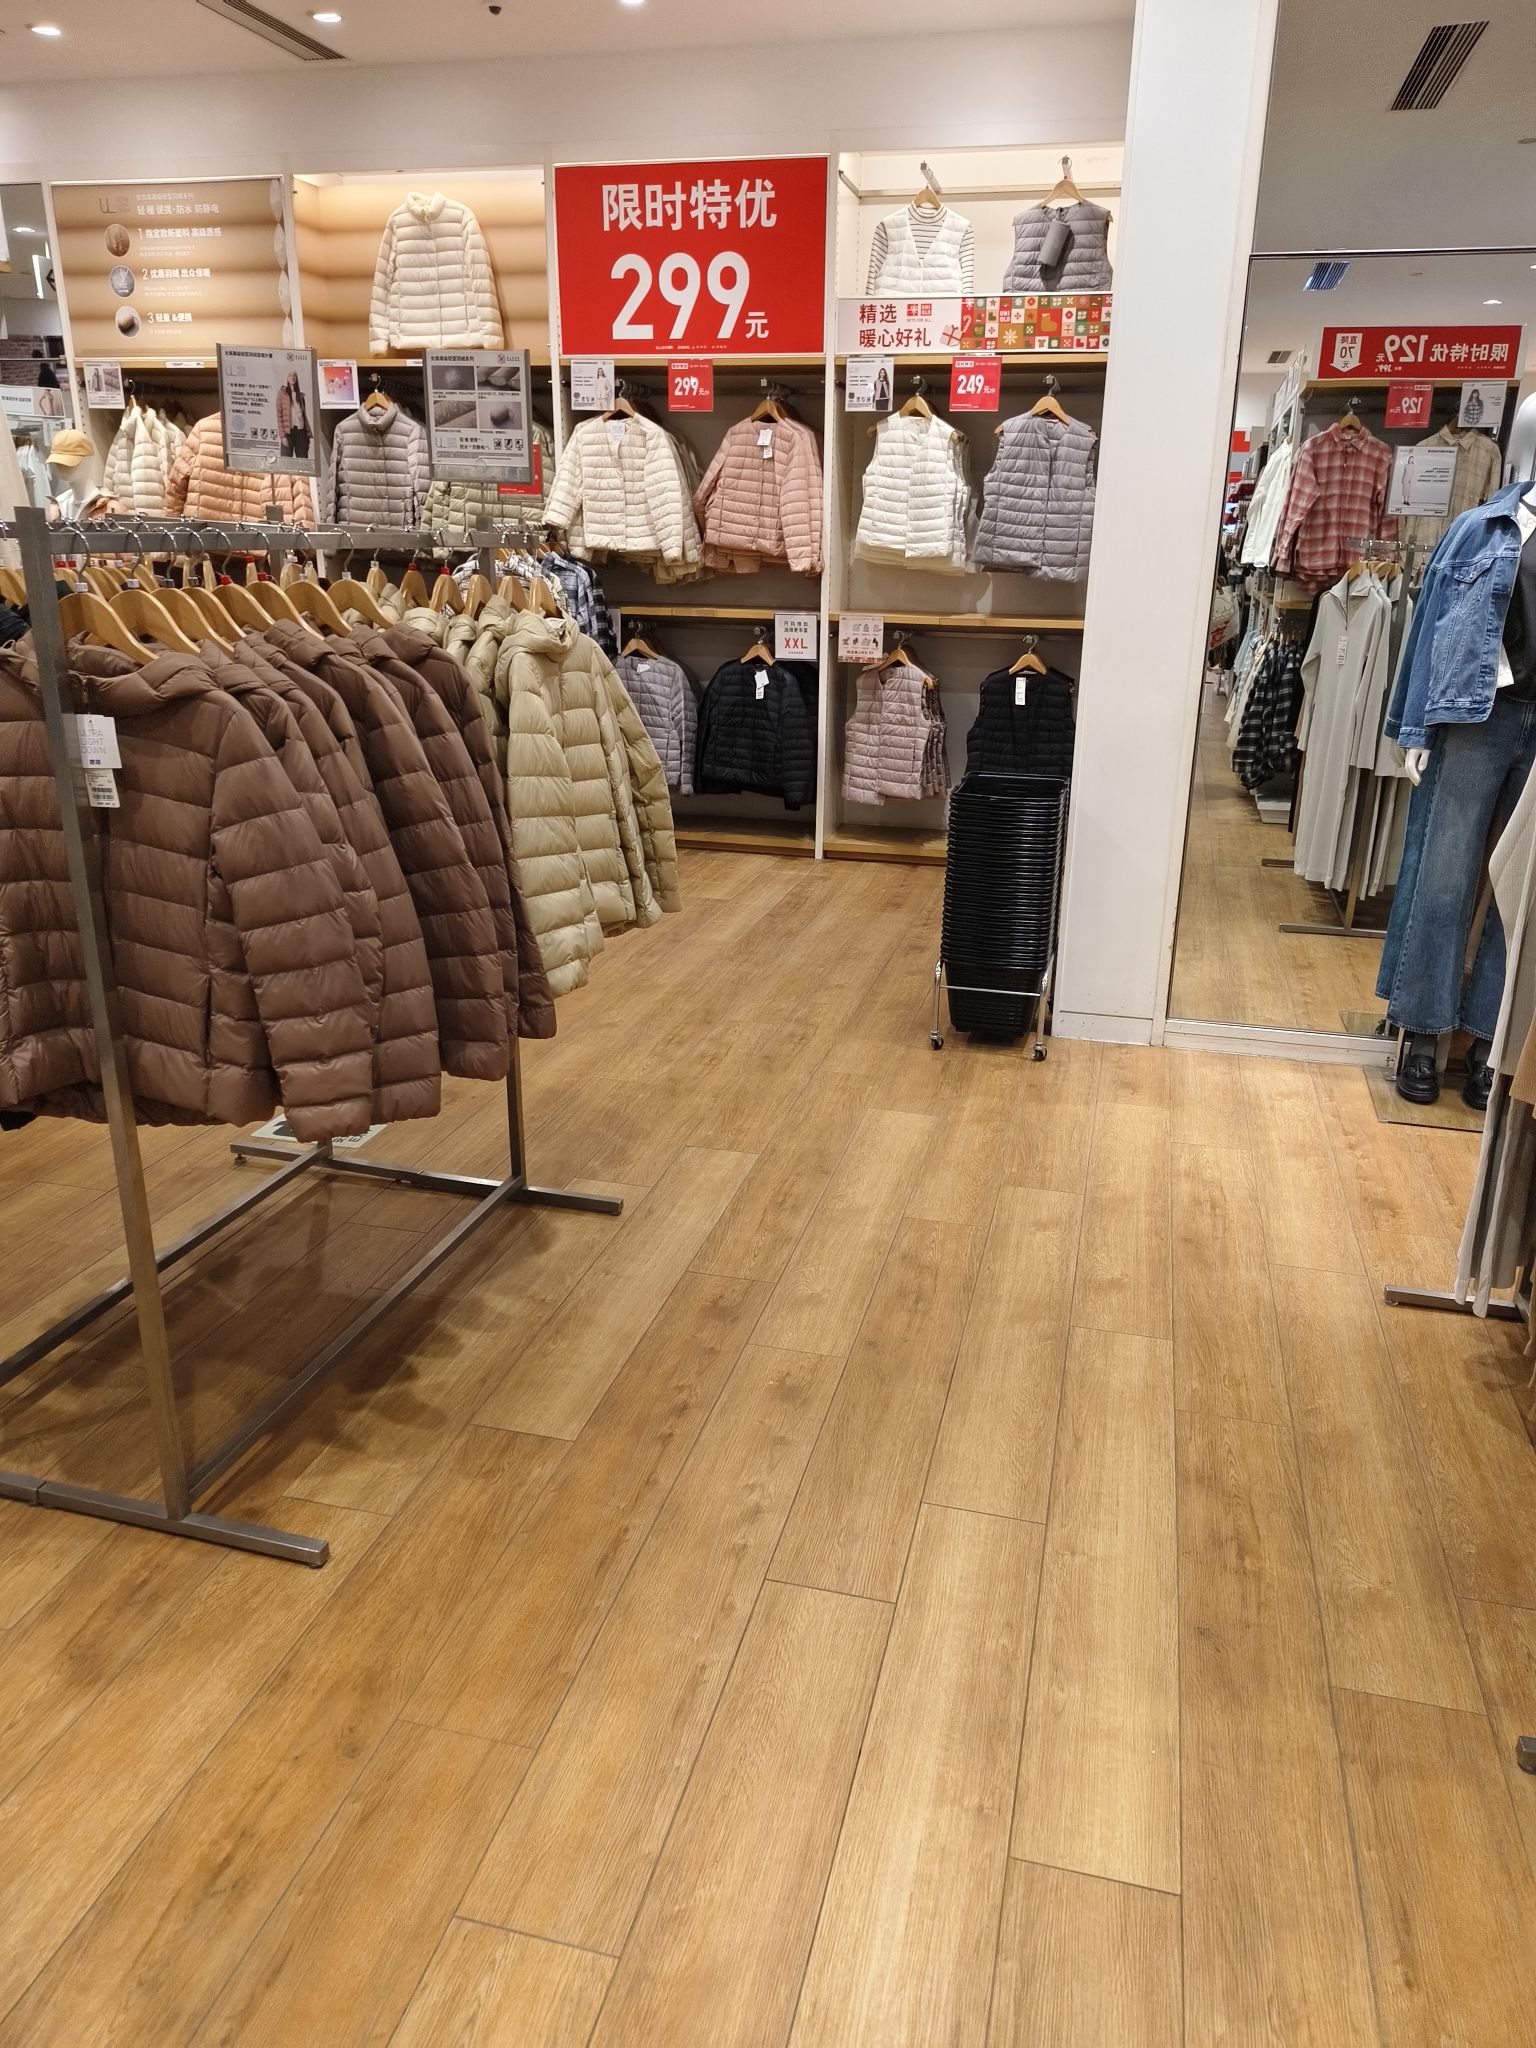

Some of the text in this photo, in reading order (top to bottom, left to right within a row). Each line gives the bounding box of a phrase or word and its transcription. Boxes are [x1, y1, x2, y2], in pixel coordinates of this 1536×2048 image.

[602, 178, 777, 231] 限时特优
[859, 303, 897, 324] 精选
[859, 327, 932, 348] 暖心好礼
[784, 637, 808, 649] XXL
